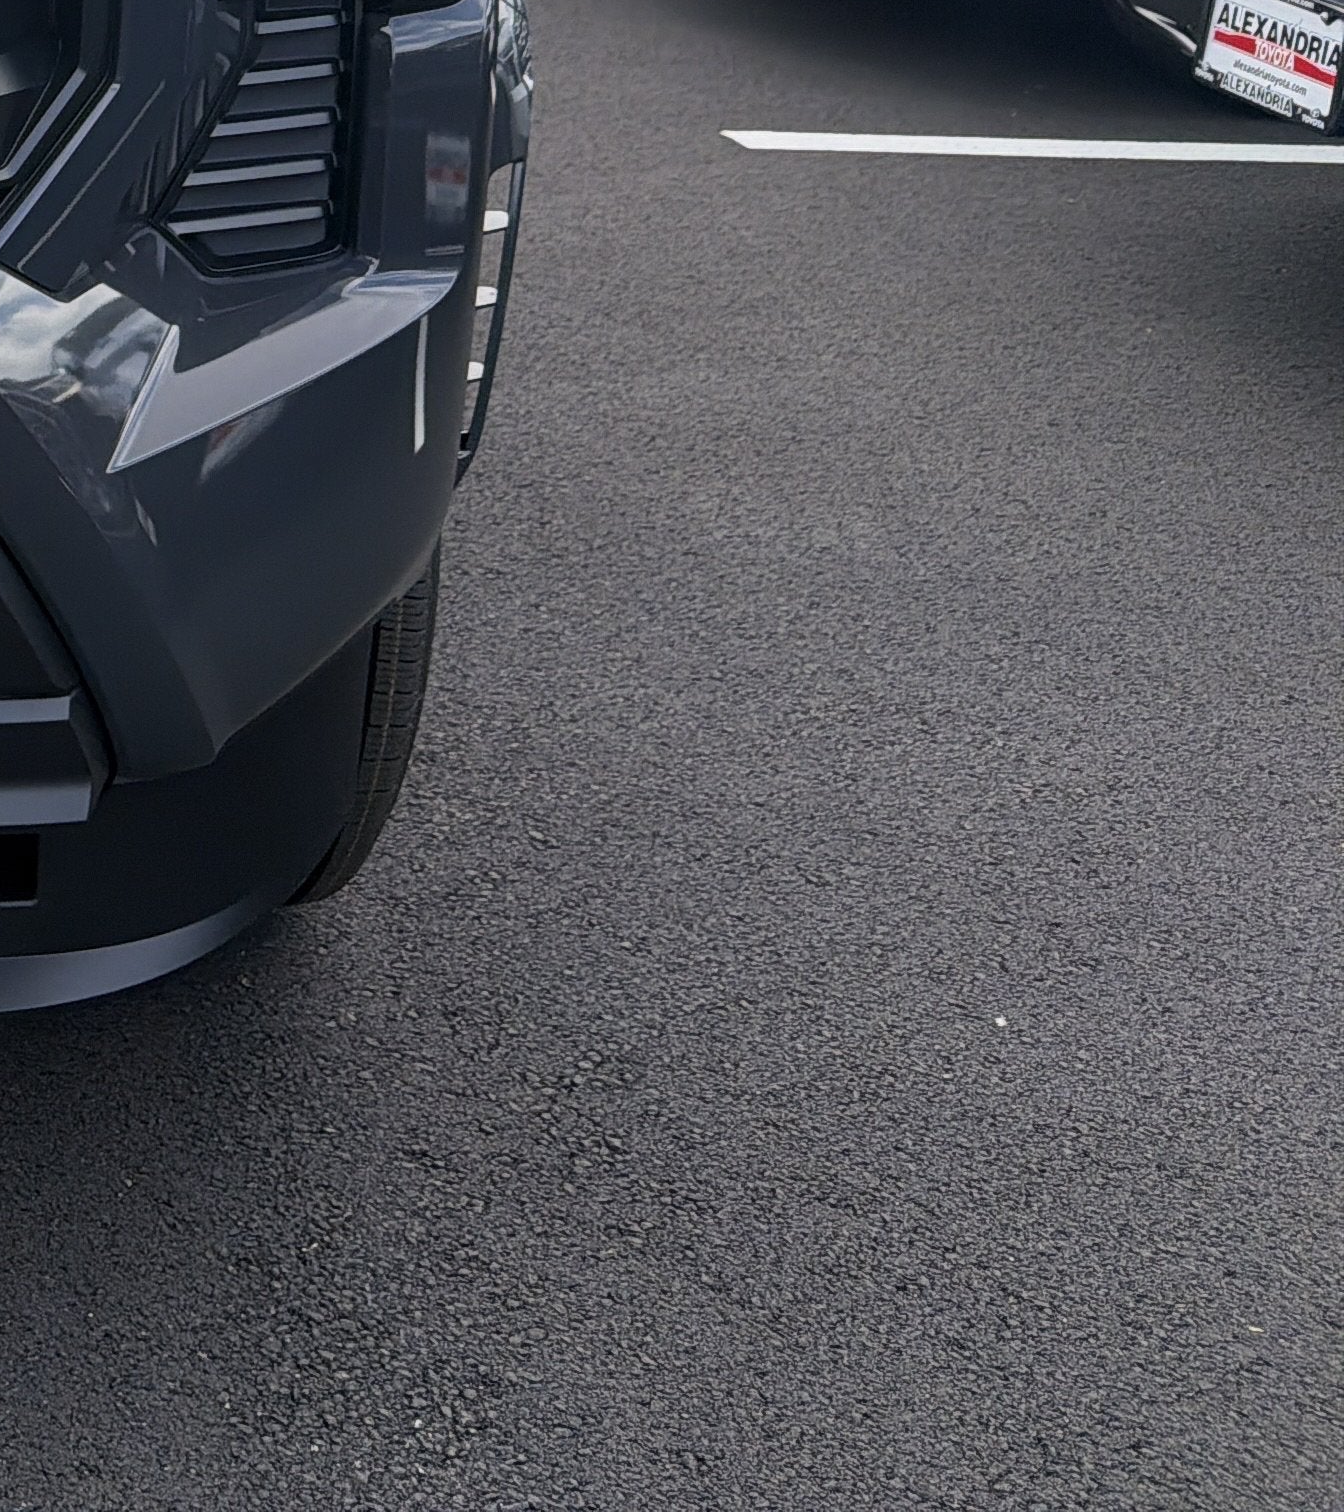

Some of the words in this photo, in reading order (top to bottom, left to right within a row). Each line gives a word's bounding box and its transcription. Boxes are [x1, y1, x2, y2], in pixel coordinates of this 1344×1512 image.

[1216, 2, 1341, 70] ALEXANDRIA
[1254, 39, 1295, 72] TOYOTA
[1222, 73, 1293, 116] ALEXANDRIA
